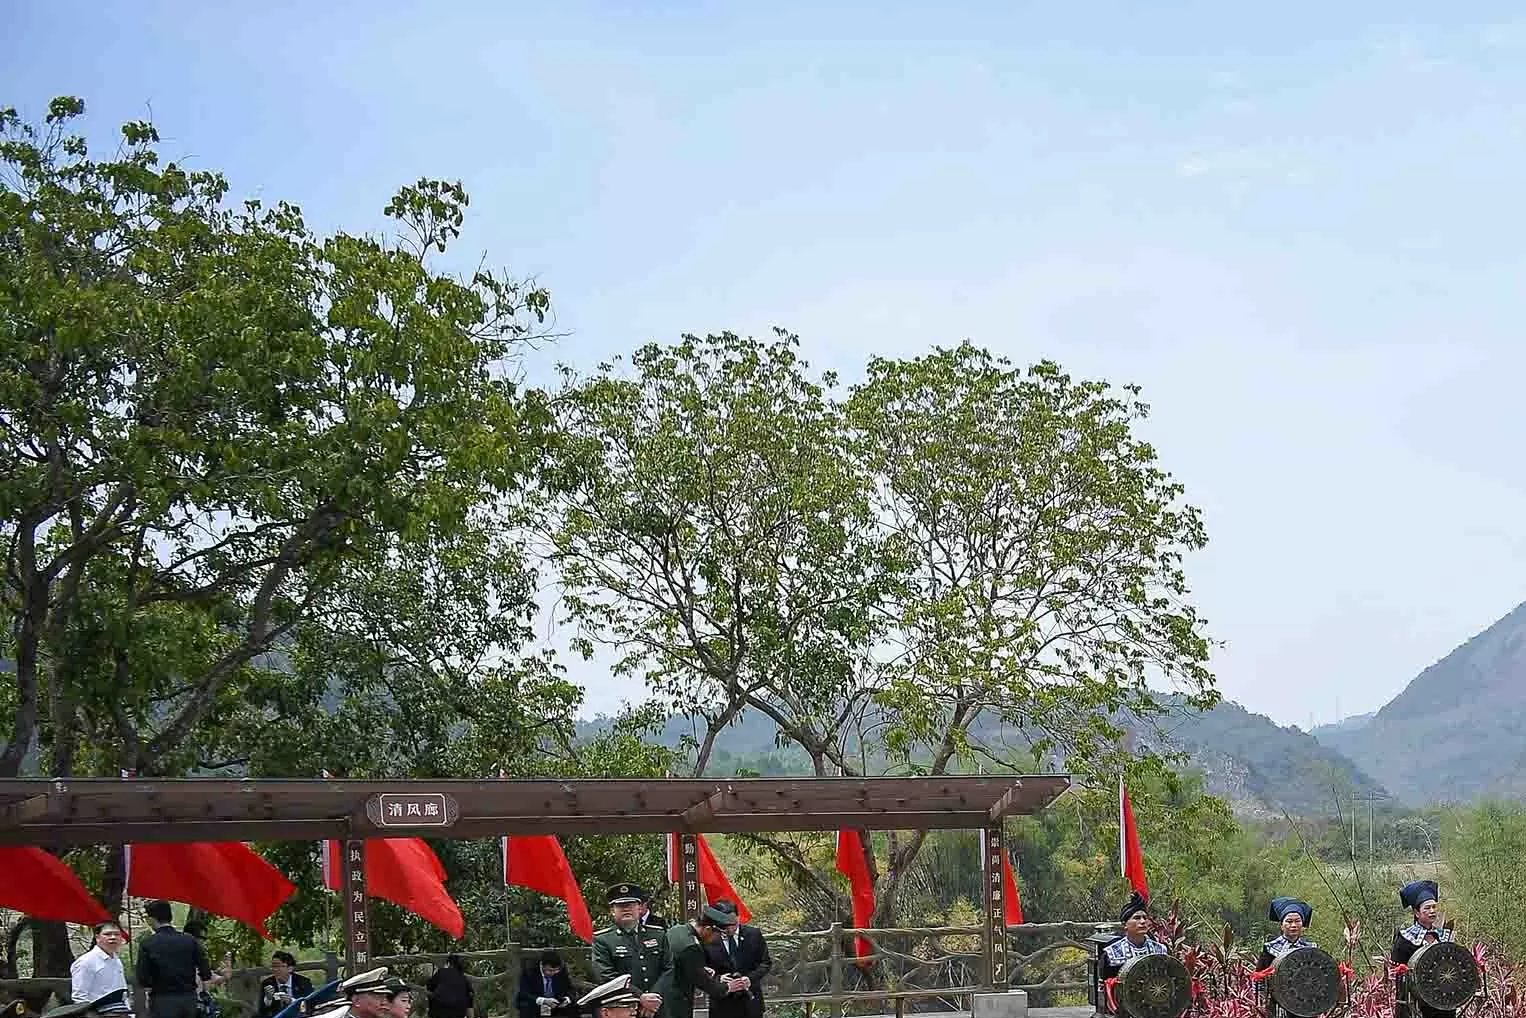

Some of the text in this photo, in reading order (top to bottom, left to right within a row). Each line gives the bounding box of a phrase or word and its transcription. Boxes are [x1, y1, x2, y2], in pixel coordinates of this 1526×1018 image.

[387, 802, 439, 817] 清风廊
[349, 849, 368, 965] 执政为民立新
